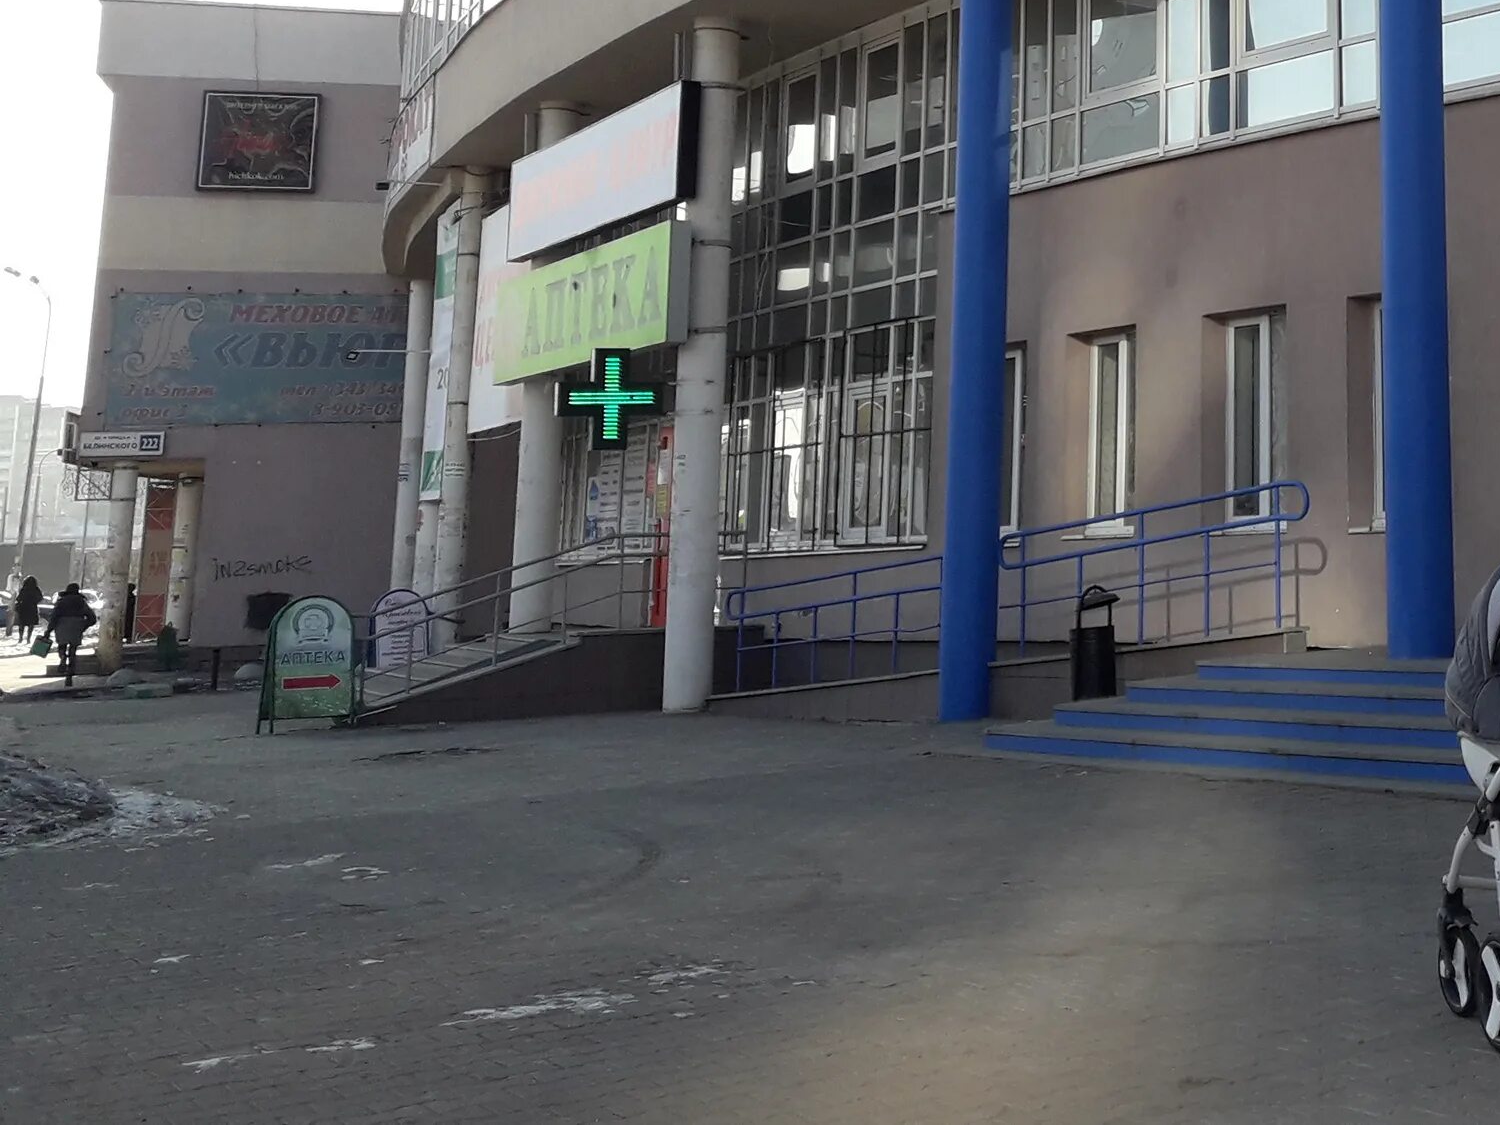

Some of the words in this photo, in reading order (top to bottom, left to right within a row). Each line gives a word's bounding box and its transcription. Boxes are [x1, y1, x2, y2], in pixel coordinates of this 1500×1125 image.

[520, 245, 663, 360] АПТЕКА
[229, 303, 363, 324] МЕХОВОЕ
[142, 437, 159, 450] 222
[280, 649, 346, 666] АПТЕКА
